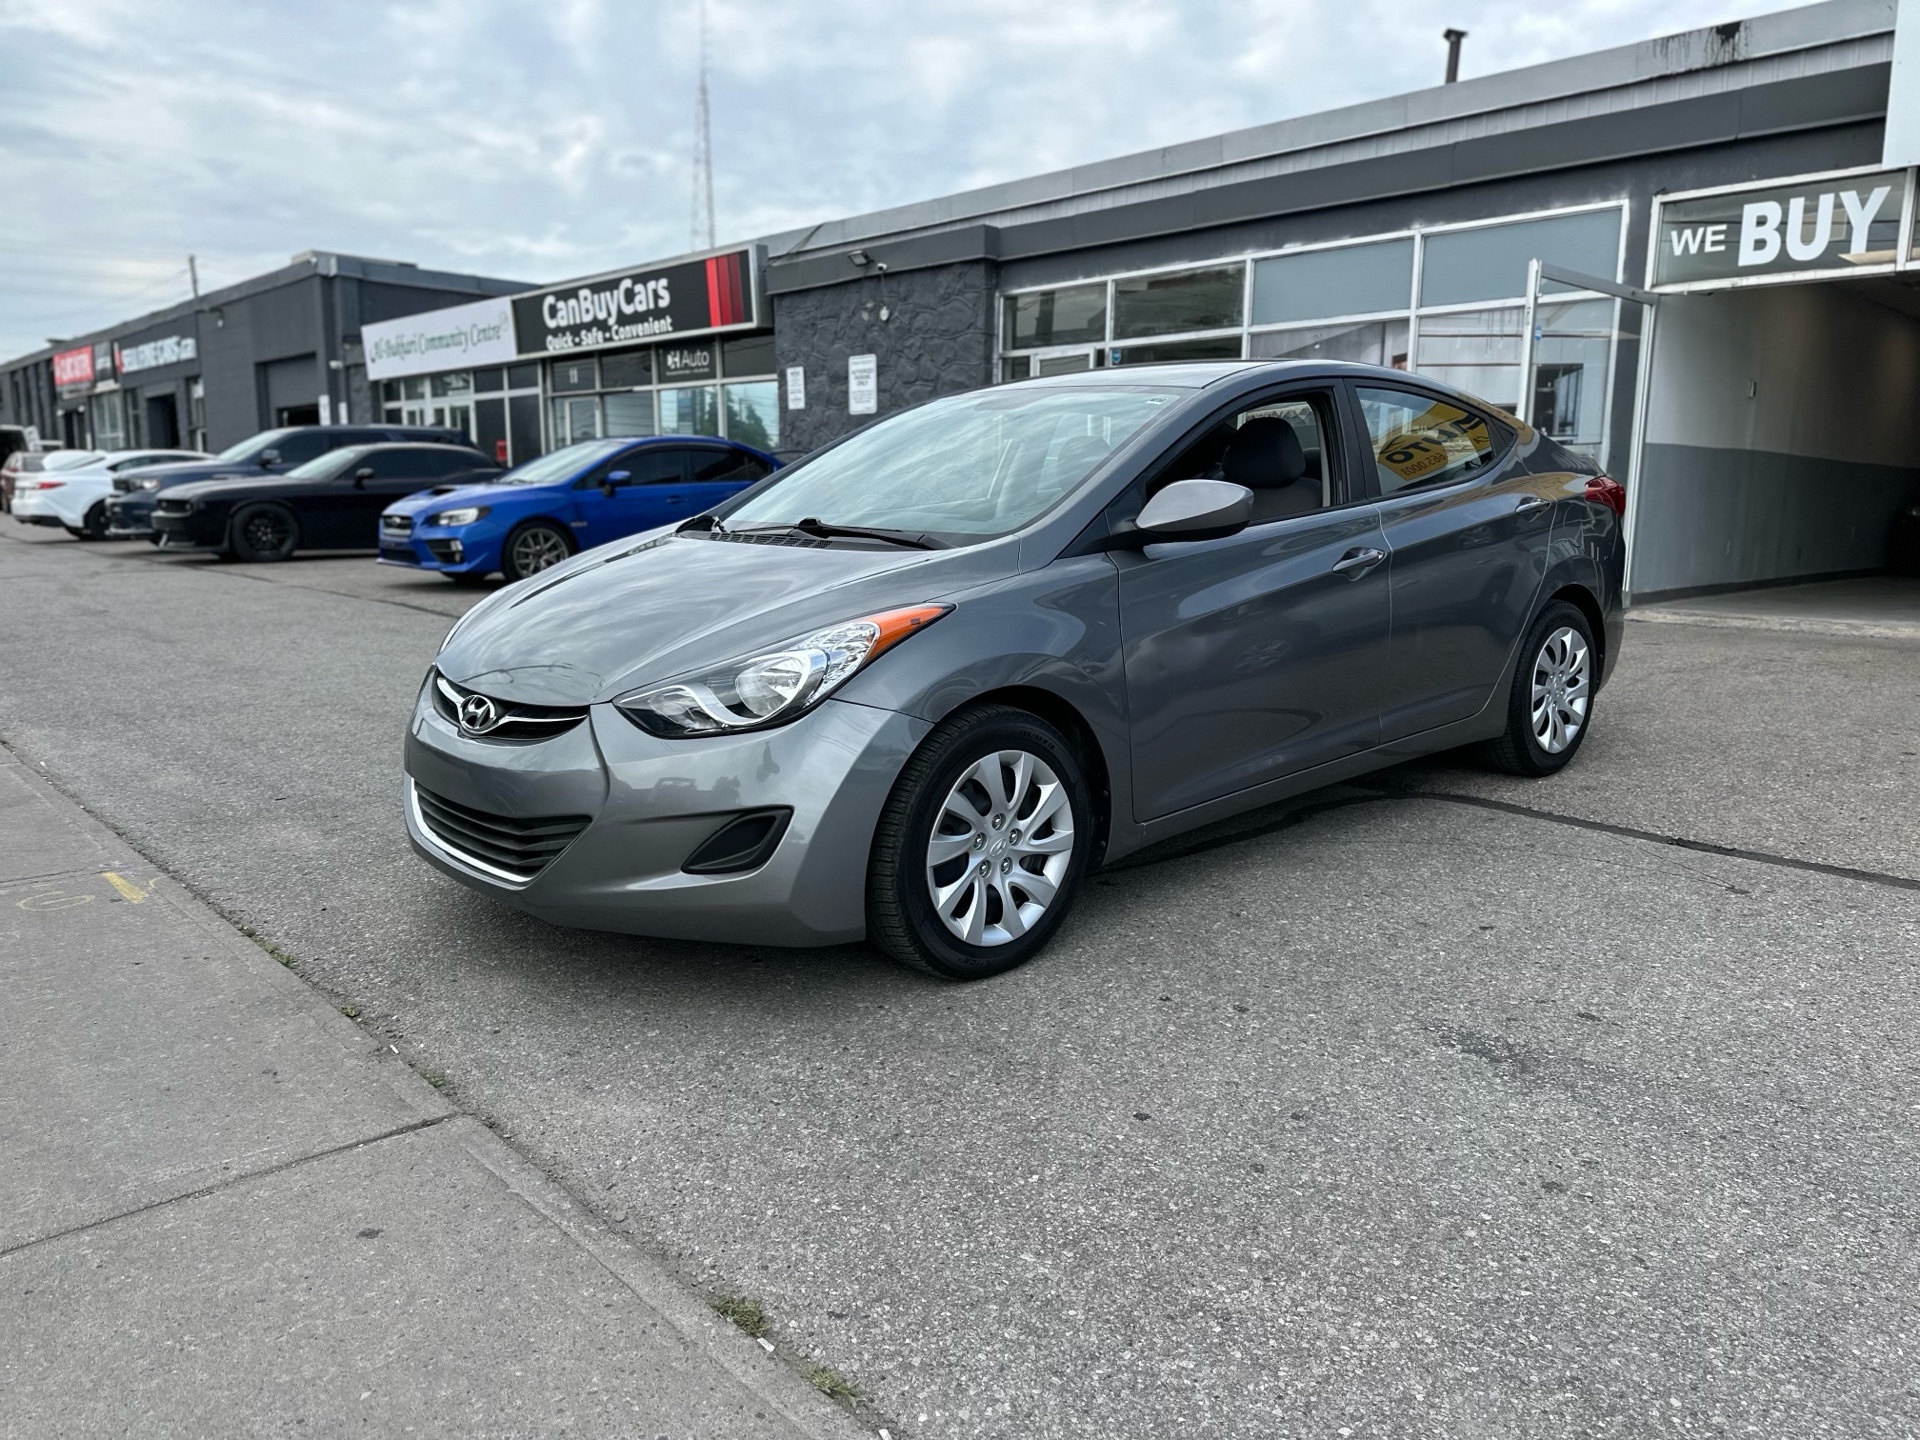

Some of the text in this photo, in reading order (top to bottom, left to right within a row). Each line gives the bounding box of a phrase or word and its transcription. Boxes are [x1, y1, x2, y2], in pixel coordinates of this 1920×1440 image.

[1671, 186, 1891, 267] WE BUY
[542, 278, 670, 329] CanBuyCars
[470, 323, 501, 347] Centre
[545, 315, 673, 352] Quick Safe Convenient
[682, 349, 710, 367] Auto
